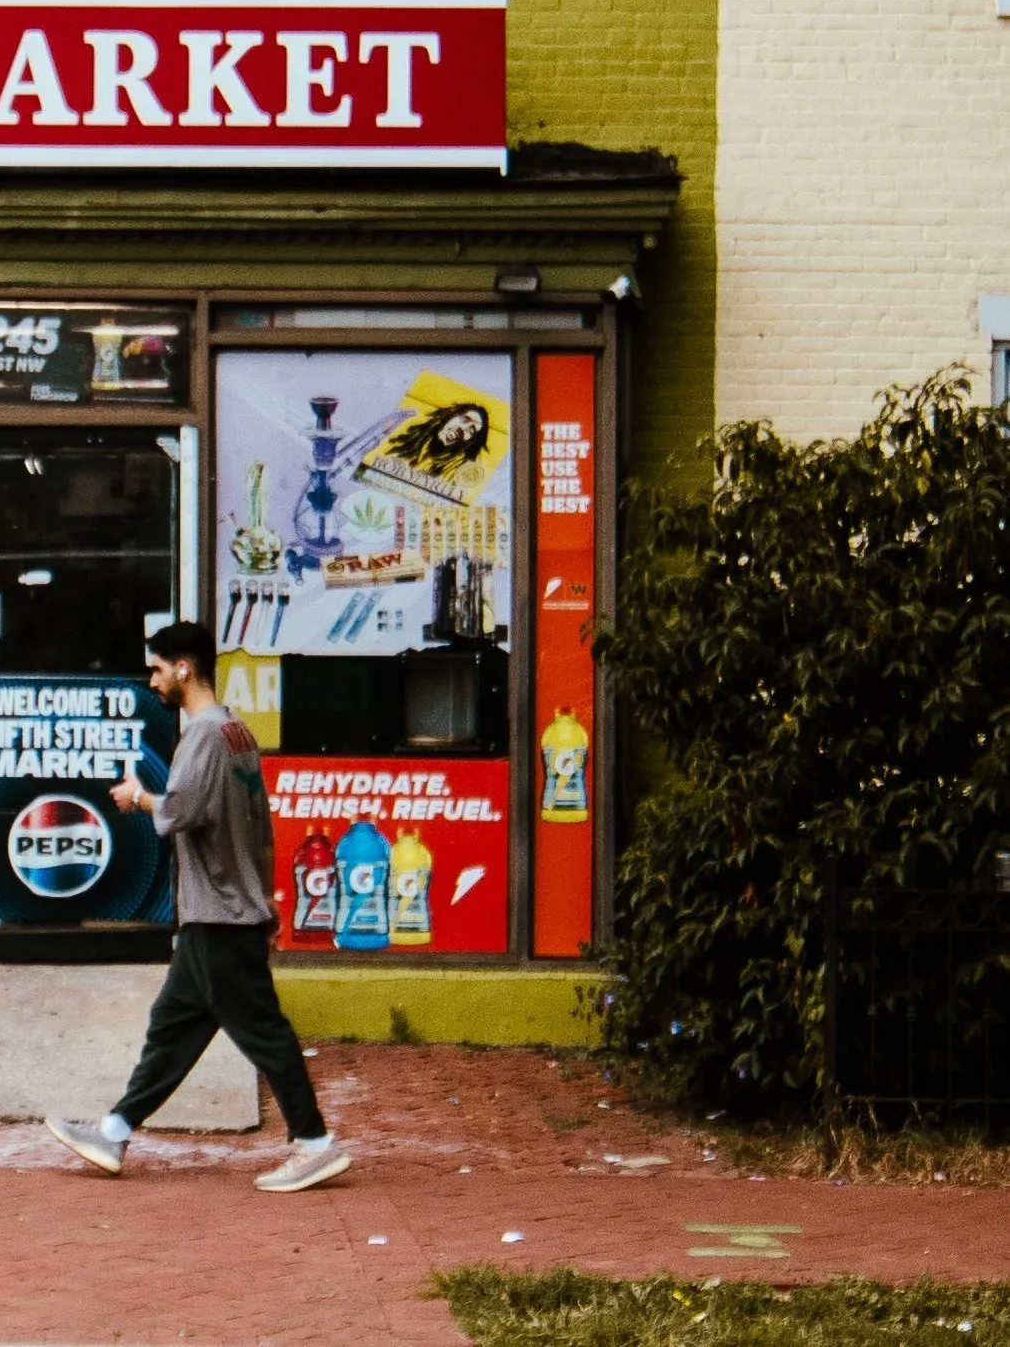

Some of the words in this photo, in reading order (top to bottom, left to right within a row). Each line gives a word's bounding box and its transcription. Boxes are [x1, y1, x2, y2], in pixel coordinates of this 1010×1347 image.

[16, 357, 48, 373] NW
[541, 422, 581, 440] THE
[541, 441, 590, 459] BEST
[541, 460, 578, 477] USE
[541, 478, 581, 495] THE
[541, 496, 591, 514] BEST
[105, 689, 136, 718] TO
[55, 720, 145, 750] STREET
[275, 771, 451, 796] REHYDRATE.
[391, 797, 502, 822] REFUEL.
[15, 835, 103, 857] PEPSI
